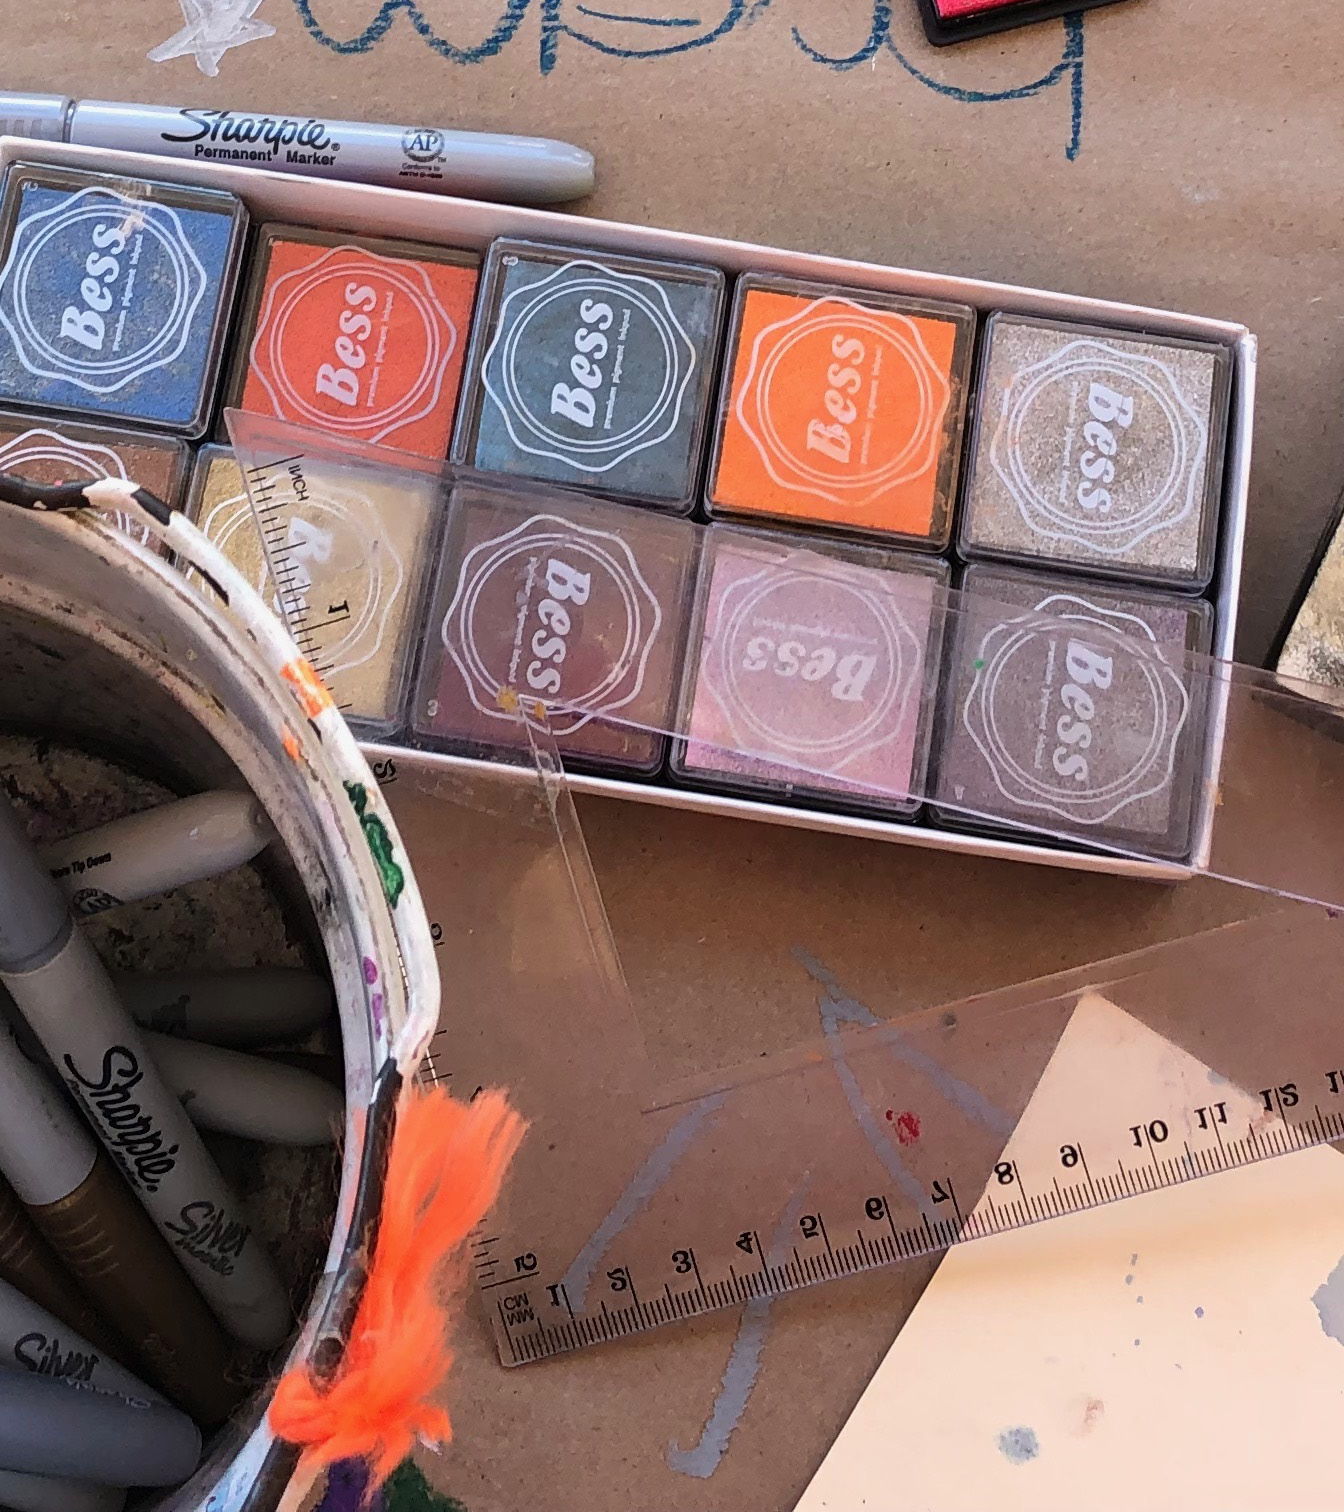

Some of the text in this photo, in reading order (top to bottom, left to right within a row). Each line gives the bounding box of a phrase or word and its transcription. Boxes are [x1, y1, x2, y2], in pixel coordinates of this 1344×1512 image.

[193, 143, 337, 167] Permanent Marker
[58, 222, 127, 351] Bess
[315, 281, 379, 408] Bess
[550, 298, 614, 430] Bess
[805, 332, 868, 466] Bess
[1083, 382, 1135, 514] Bess
[526, 557, 592, 696] Bess
[742, 634, 879, 702] Bess
[1053, 639, 1116, 782] Bess
[63, 1045, 180, 1193] Sharpie
[164, 1200, 252, 1257] Silver
